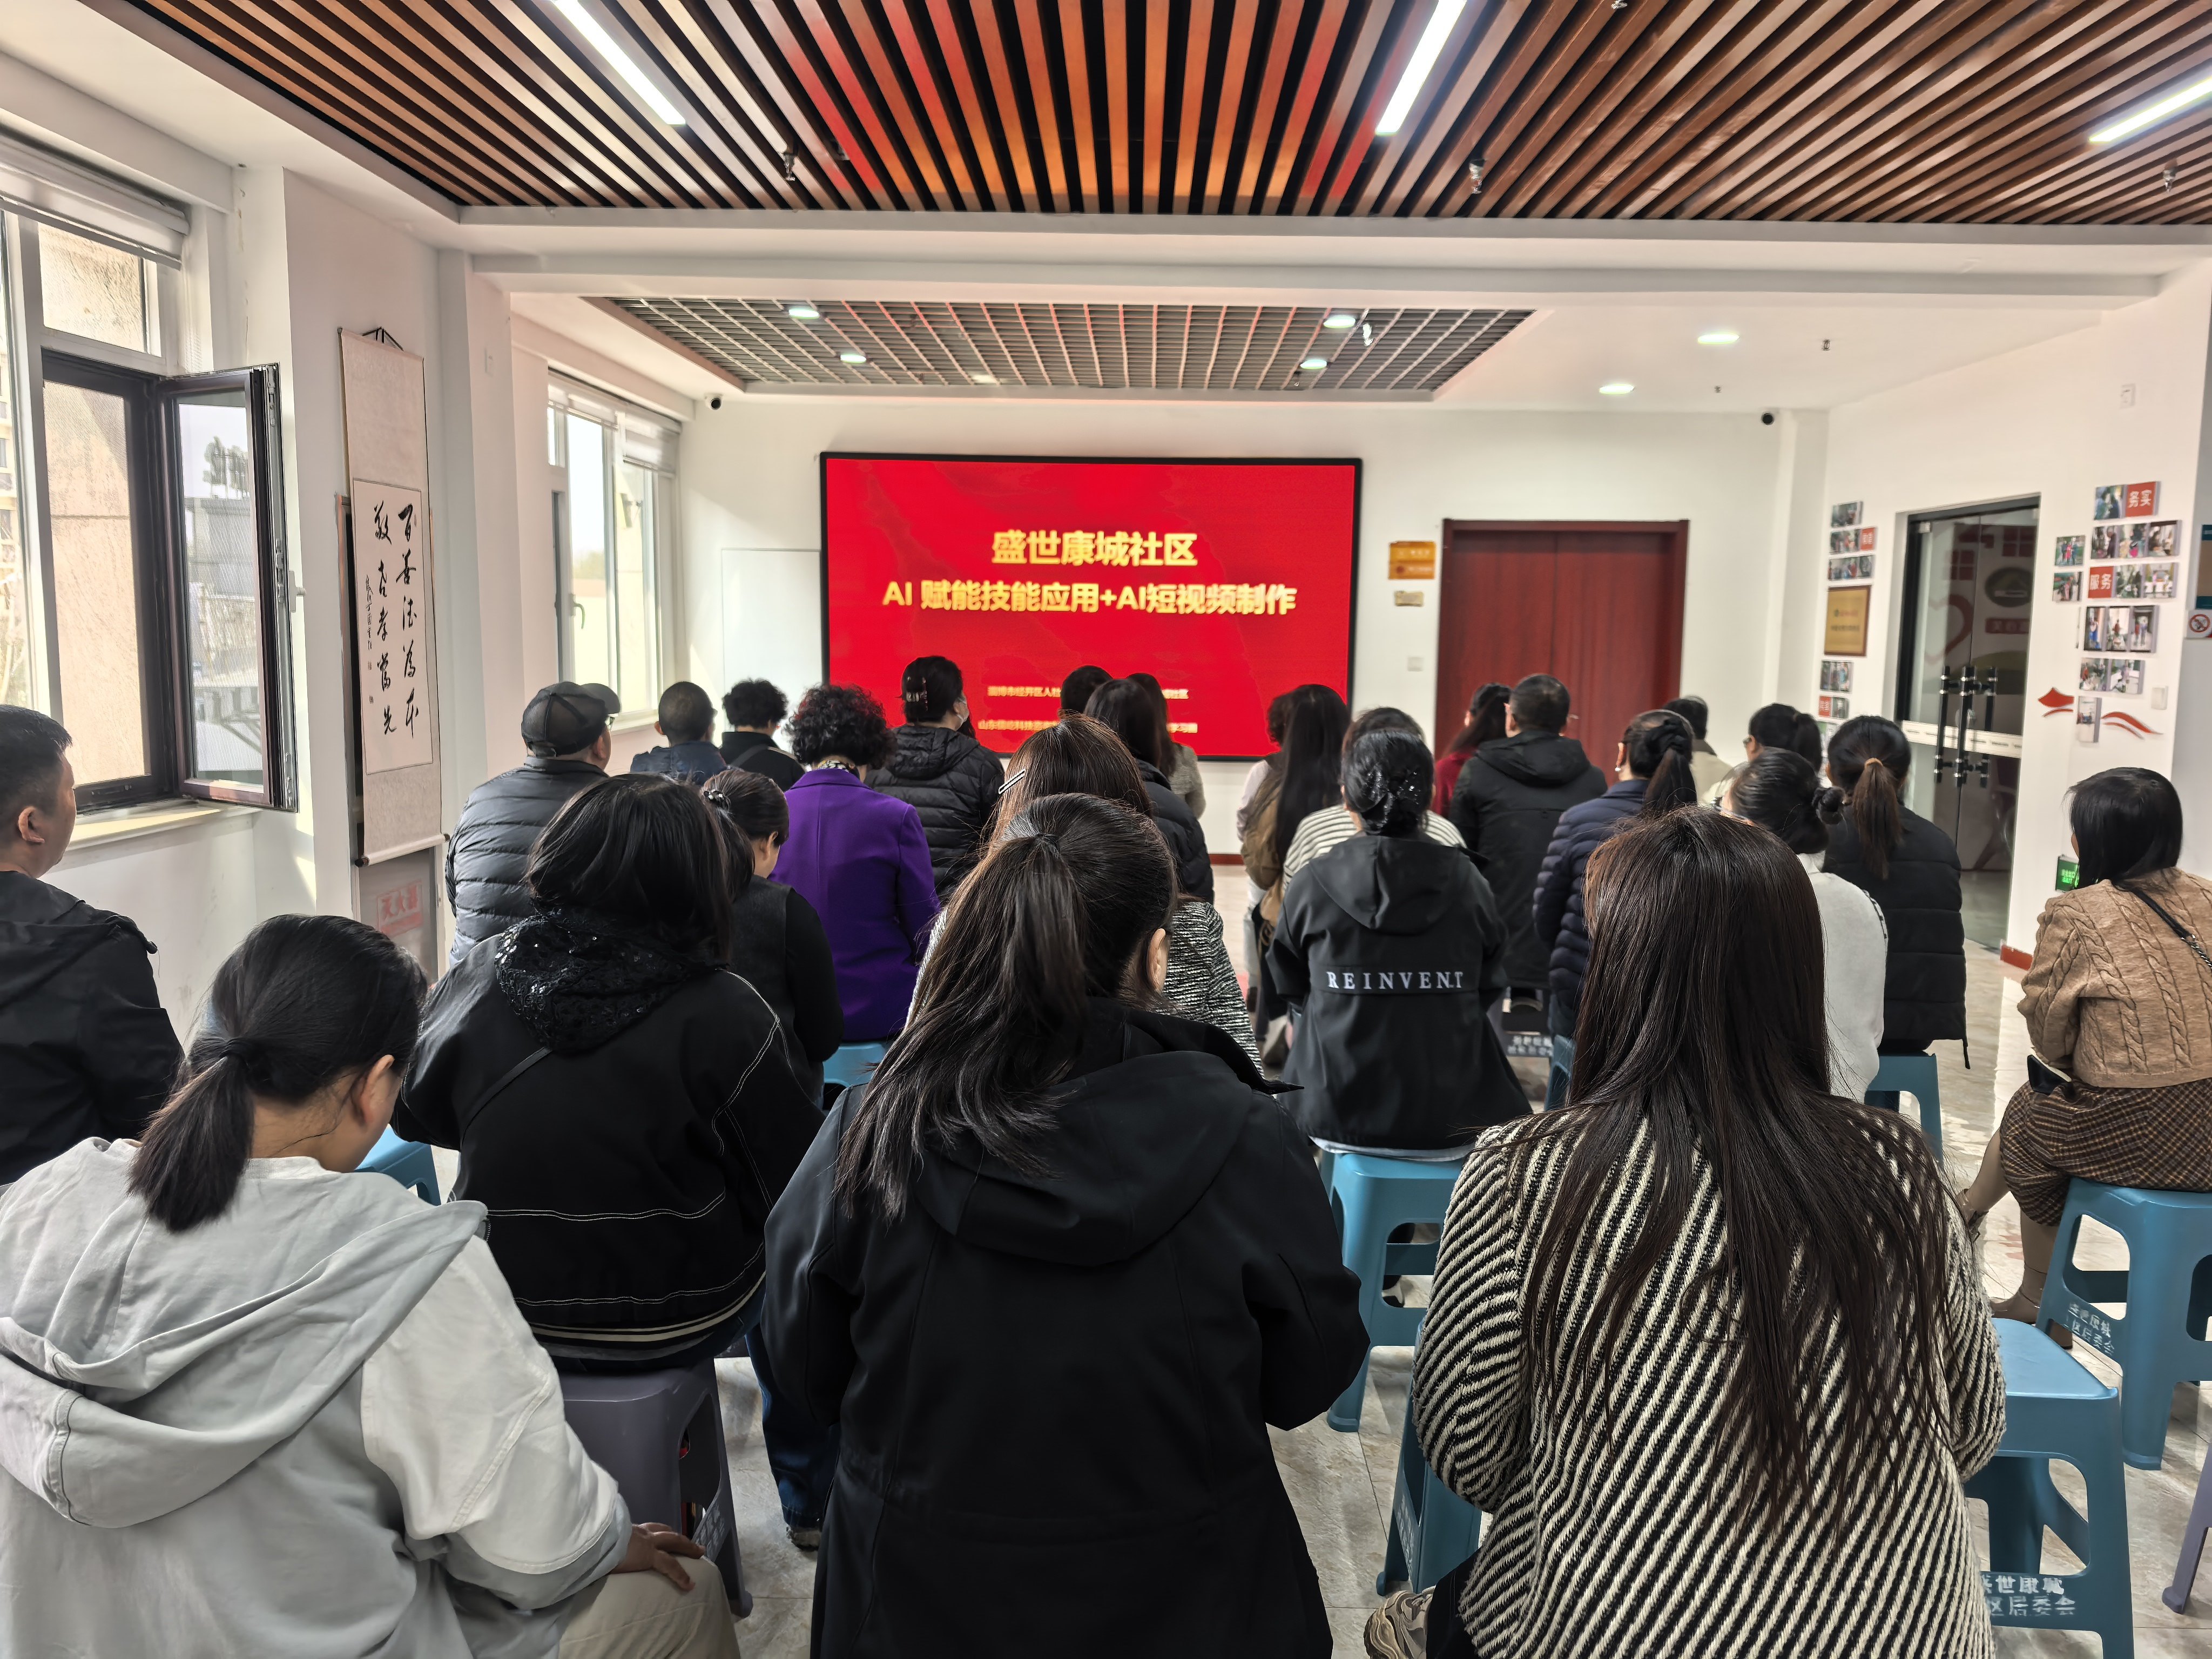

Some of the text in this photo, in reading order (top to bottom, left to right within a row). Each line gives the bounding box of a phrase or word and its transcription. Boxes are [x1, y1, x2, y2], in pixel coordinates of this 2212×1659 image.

[2128, 489, 2152, 508] 务实
[992, 530, 1198, 567] 盛世康城社区
[2089, 574, 2112, 591] 服务
[883, 580, 1297, 615] AI 赋能技能应用+AI短视频制作
[1326, 971, 1463, 989] REINVENT
